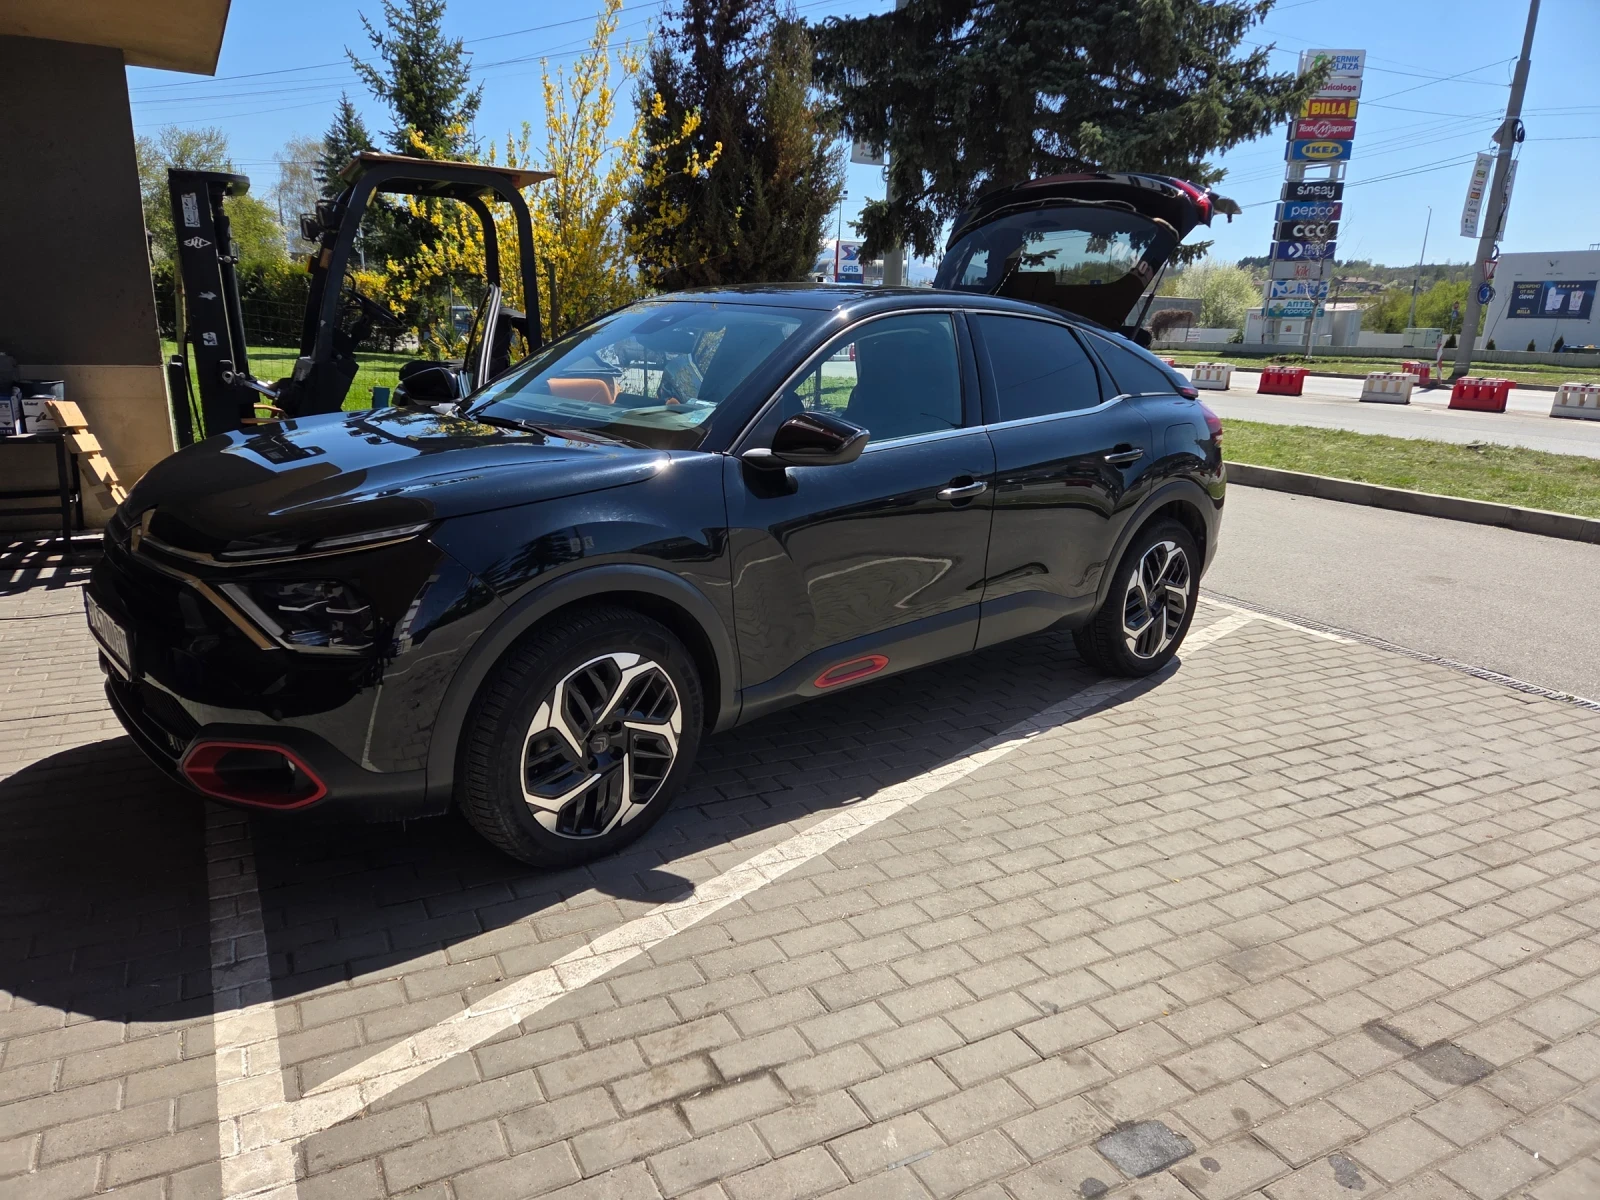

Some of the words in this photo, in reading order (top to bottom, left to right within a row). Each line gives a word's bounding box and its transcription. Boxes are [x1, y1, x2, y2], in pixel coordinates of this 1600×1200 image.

[1311, 102, 1347, 115] BILLA
[1306, 146, 1339, 154] IKEA
[1297, 184, 1336, 198] sinsay
[1291, 206, 1334, 218] pepco
